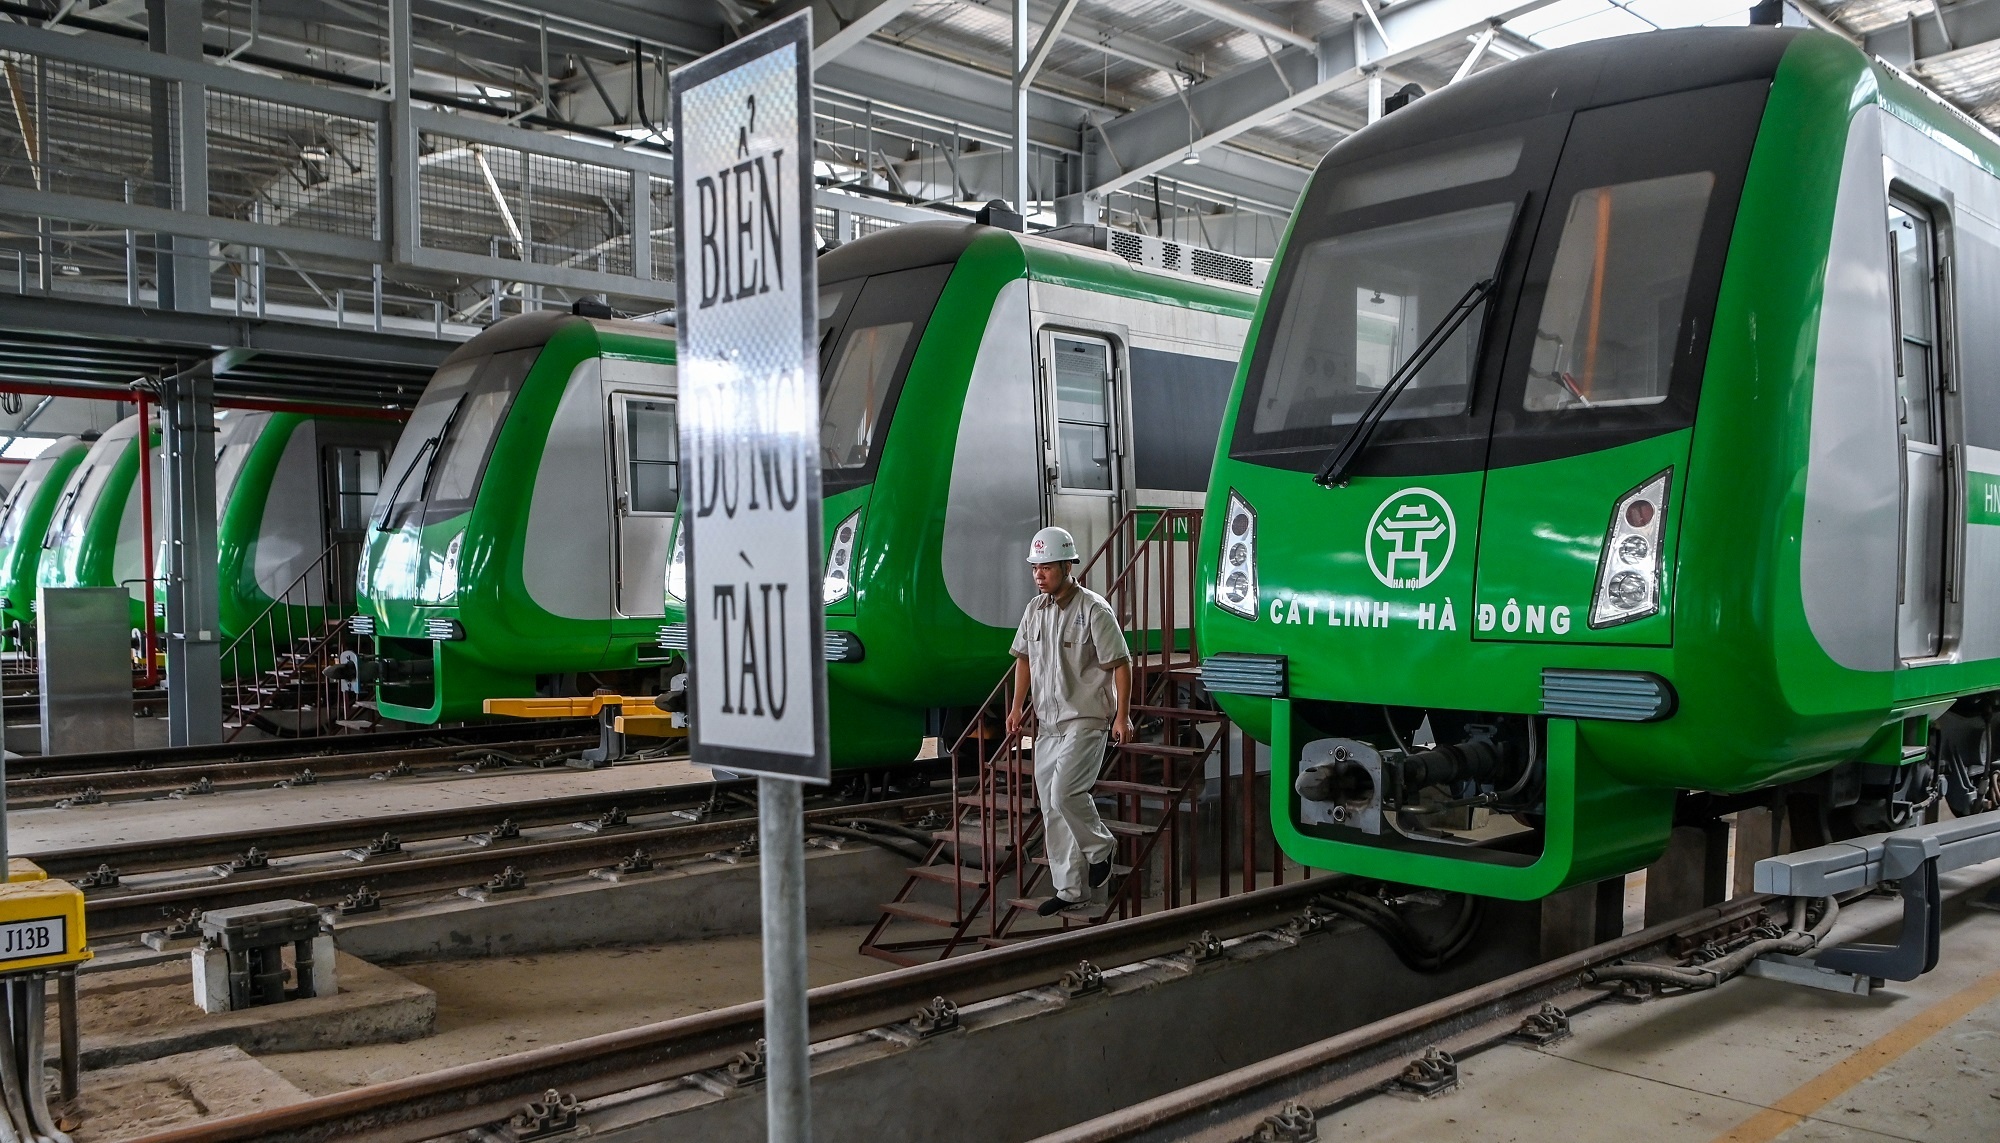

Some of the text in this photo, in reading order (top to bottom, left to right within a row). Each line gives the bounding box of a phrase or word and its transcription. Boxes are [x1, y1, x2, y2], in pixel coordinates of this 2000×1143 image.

[697, 95, 783, 309] BIỂN
[1393, 577, 1419, 591] HÀ NỘI
[713, 550, 788, 720] TÀU
[1270, 594, 1318, 625] CÁT
[1328, 600, 1389, 628] LINH
[1418, 597, 1456, 631] HÀ
[1478, 598, 1570, 635] ĐÔNG
[5, 927, 50, 953] J13B
